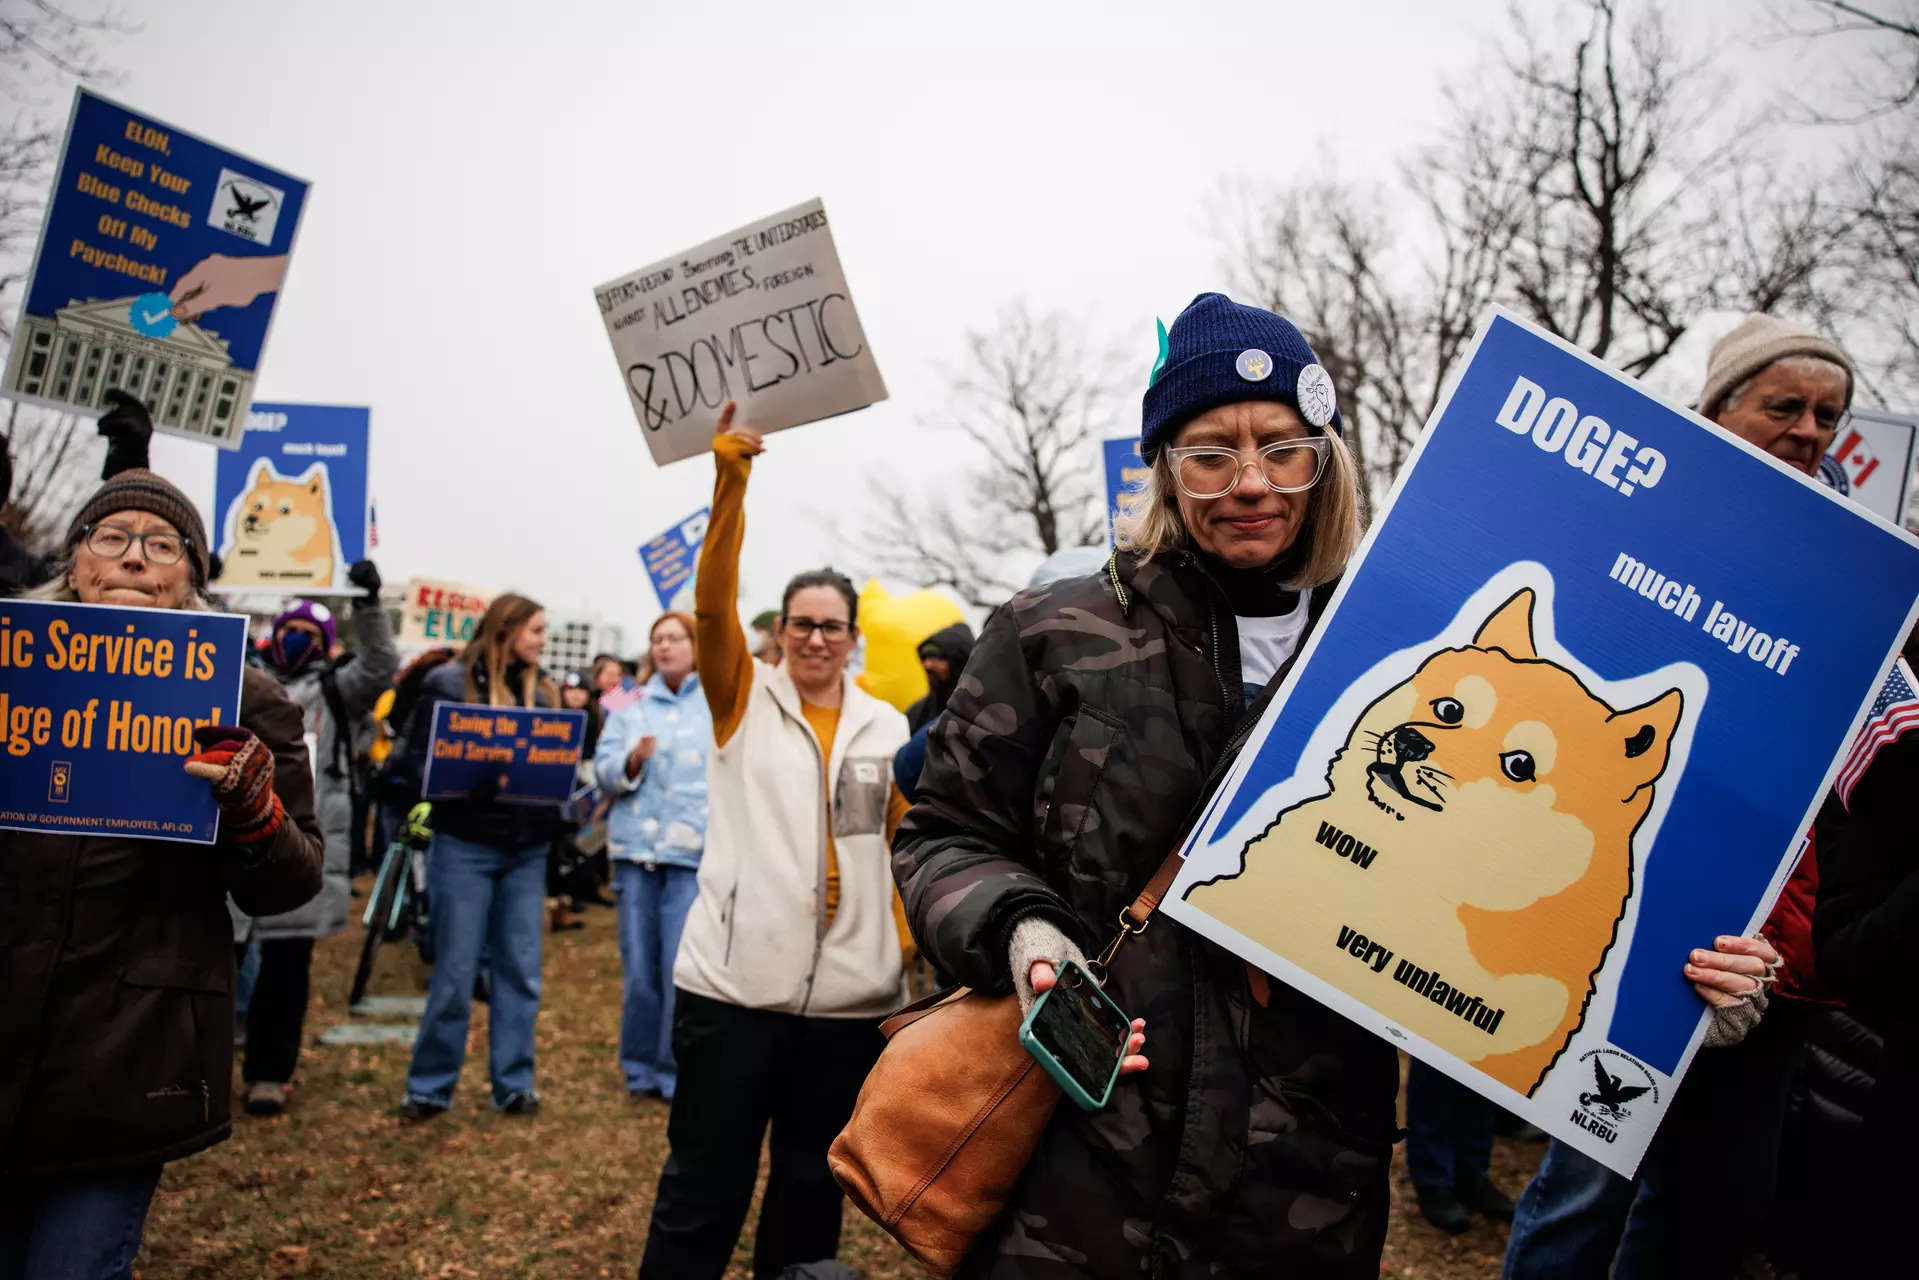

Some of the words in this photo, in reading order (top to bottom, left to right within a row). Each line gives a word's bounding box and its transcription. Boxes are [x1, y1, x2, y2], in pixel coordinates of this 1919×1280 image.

[125, 120, 171, 155] ELON,
[95, 143, 143, 179] Keep
[150, 164, 192, 195] Your
[77, 171, 121, 204] Blue
[125, 188, 191, 228] Checks
[98, 215, 126, 240] Off
[130, 226, 158, 251] My
[70, 239, 168, 286] Paycheck!
[653, 295, 687, 331] ALL
[762, 262, 815, 291] FOREIGN
[626, 362, 673, 432] &
[657, 292, 863, 420] DOMESTIC
[1495, 375, 1667, 498] DOGE?
[424, 609, 479, 641] ELO
[1608, 551, 1702, 623] much
[1702, 600, 1800, 676] layoff
[0, 616, 34, 668] ic
[46, 619, 174, 678] Service
[184, 629, 216, 680] is
[62, 698, 99, 749] of
[448, 711, 493, 739] Saving
[495, 715, 518, 736] the
[433, 739, 463, 760] Civil
[465, 739, 514, 763] Service
[26, 813, 38, 822] OF
[39, 814, 105, 827] GOVERNMENT
[1315, 820, 1379, 870] wow
[1335, 925, 1394, 973] very
[1393, 957, 1505, 1036] unlawful
[1579, 1048, 1602, 1063] NATIONAL
[1620, 1052, 1645, 1071] RELATIONS
[1569, 1109, 1618, 1144] NLRBU
